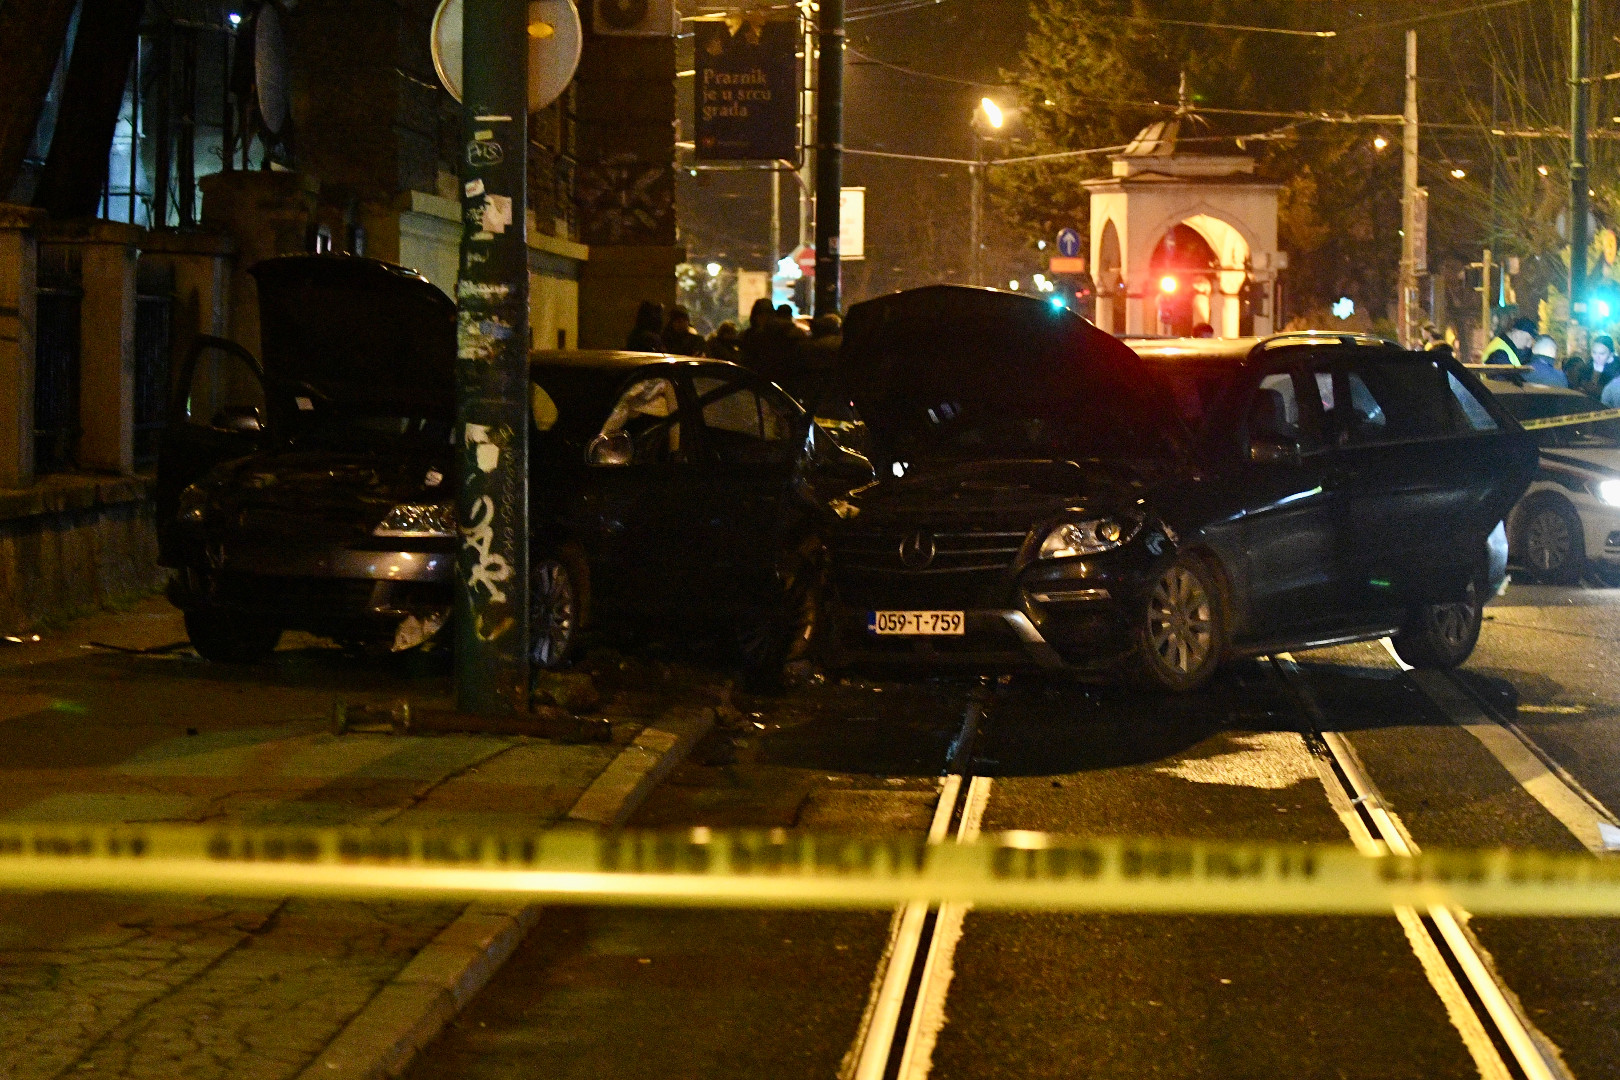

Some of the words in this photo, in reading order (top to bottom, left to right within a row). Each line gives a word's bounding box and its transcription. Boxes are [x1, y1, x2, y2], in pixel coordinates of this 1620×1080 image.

[703, 68, 767, 84] Praznik
[703, 86, 717, 103] je
[721, 89, 733, 101] u
[738, 89, 771, 101] srcu
[702, 101, 748, 121] grada
[878, 614, 961, 631] 059-T-759
